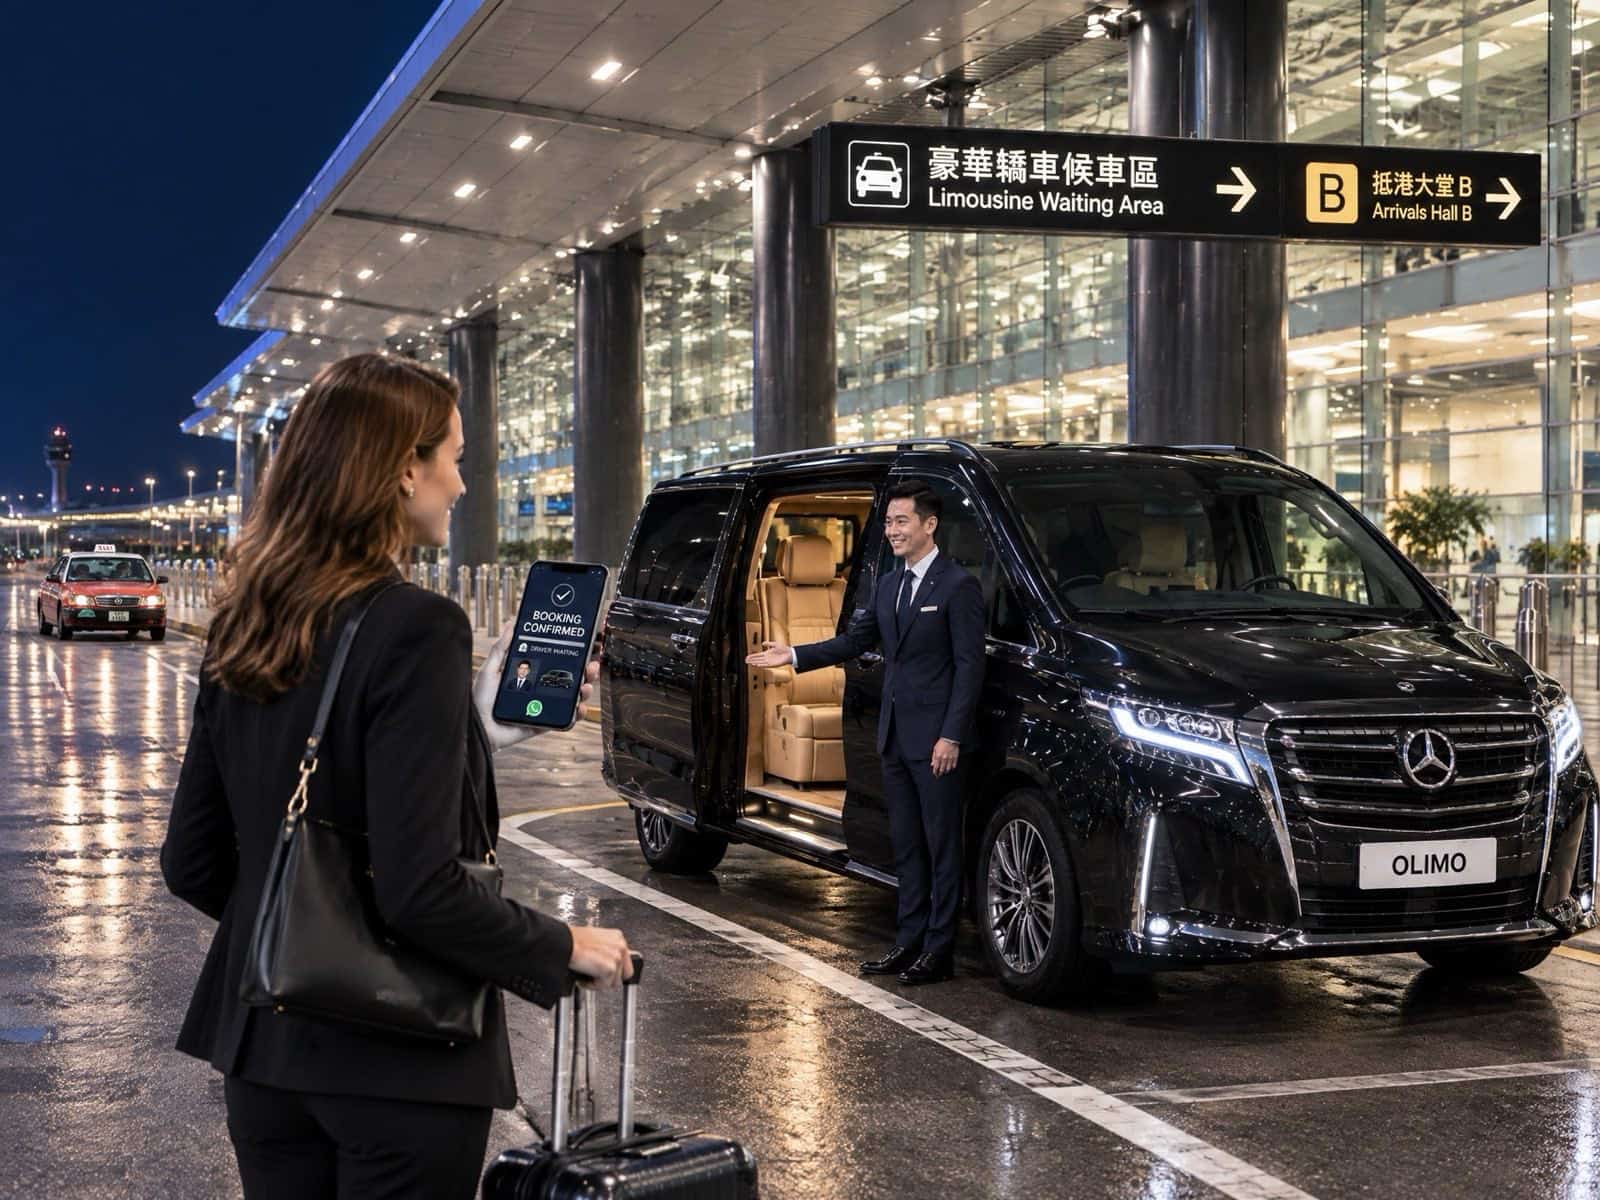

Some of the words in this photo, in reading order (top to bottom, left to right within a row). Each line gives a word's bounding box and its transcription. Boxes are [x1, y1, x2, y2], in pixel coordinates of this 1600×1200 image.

[928, 145, 1159, 188] 豪華轎車候車區
[1319, 172, 1346, 213] B
[1372, 170, 1455, 198] 抵港大堂
[1459, 176, 1473, 198] B
[928, 186, 1034, 211] Limousine
[1039, 191, 1114, 218] Waiting
[1118, 194, 1165, 215] Area
[1372, 202, 1428, 220] Arrivals
[1431, 204, 1458, 221] Hall
[1462, 205, 1473, 222] B
[523, 621, 585, 637] CONFIRMED
[532, 610, 582, 624] BOOKING
[1392, 852, 1467, 876] OLIMO
